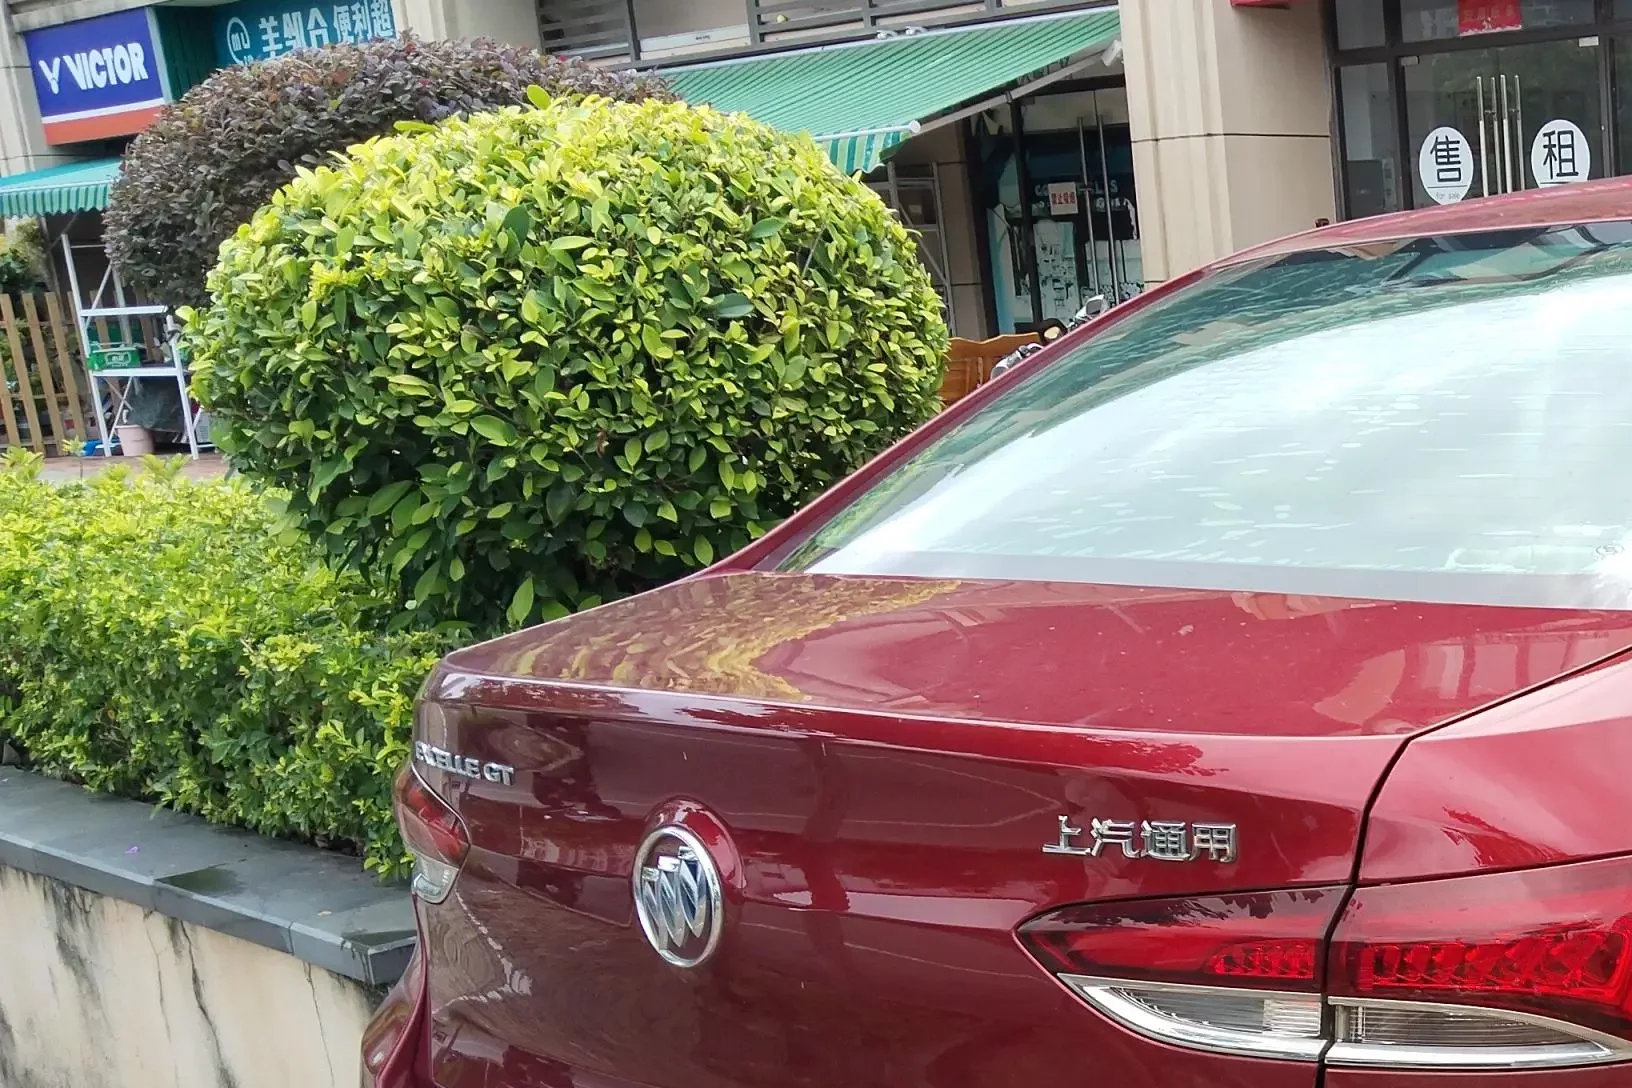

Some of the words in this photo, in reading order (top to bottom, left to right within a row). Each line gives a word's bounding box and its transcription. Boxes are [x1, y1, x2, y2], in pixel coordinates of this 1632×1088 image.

[62, 42, 149, 91] VICTOR
[1430, 135, 1462, 182] 售
[1542, 129, 1579, 180] 租
[483, 762, 515, 786] GT
[1042, 815, 1237, 863] 上汽通用
